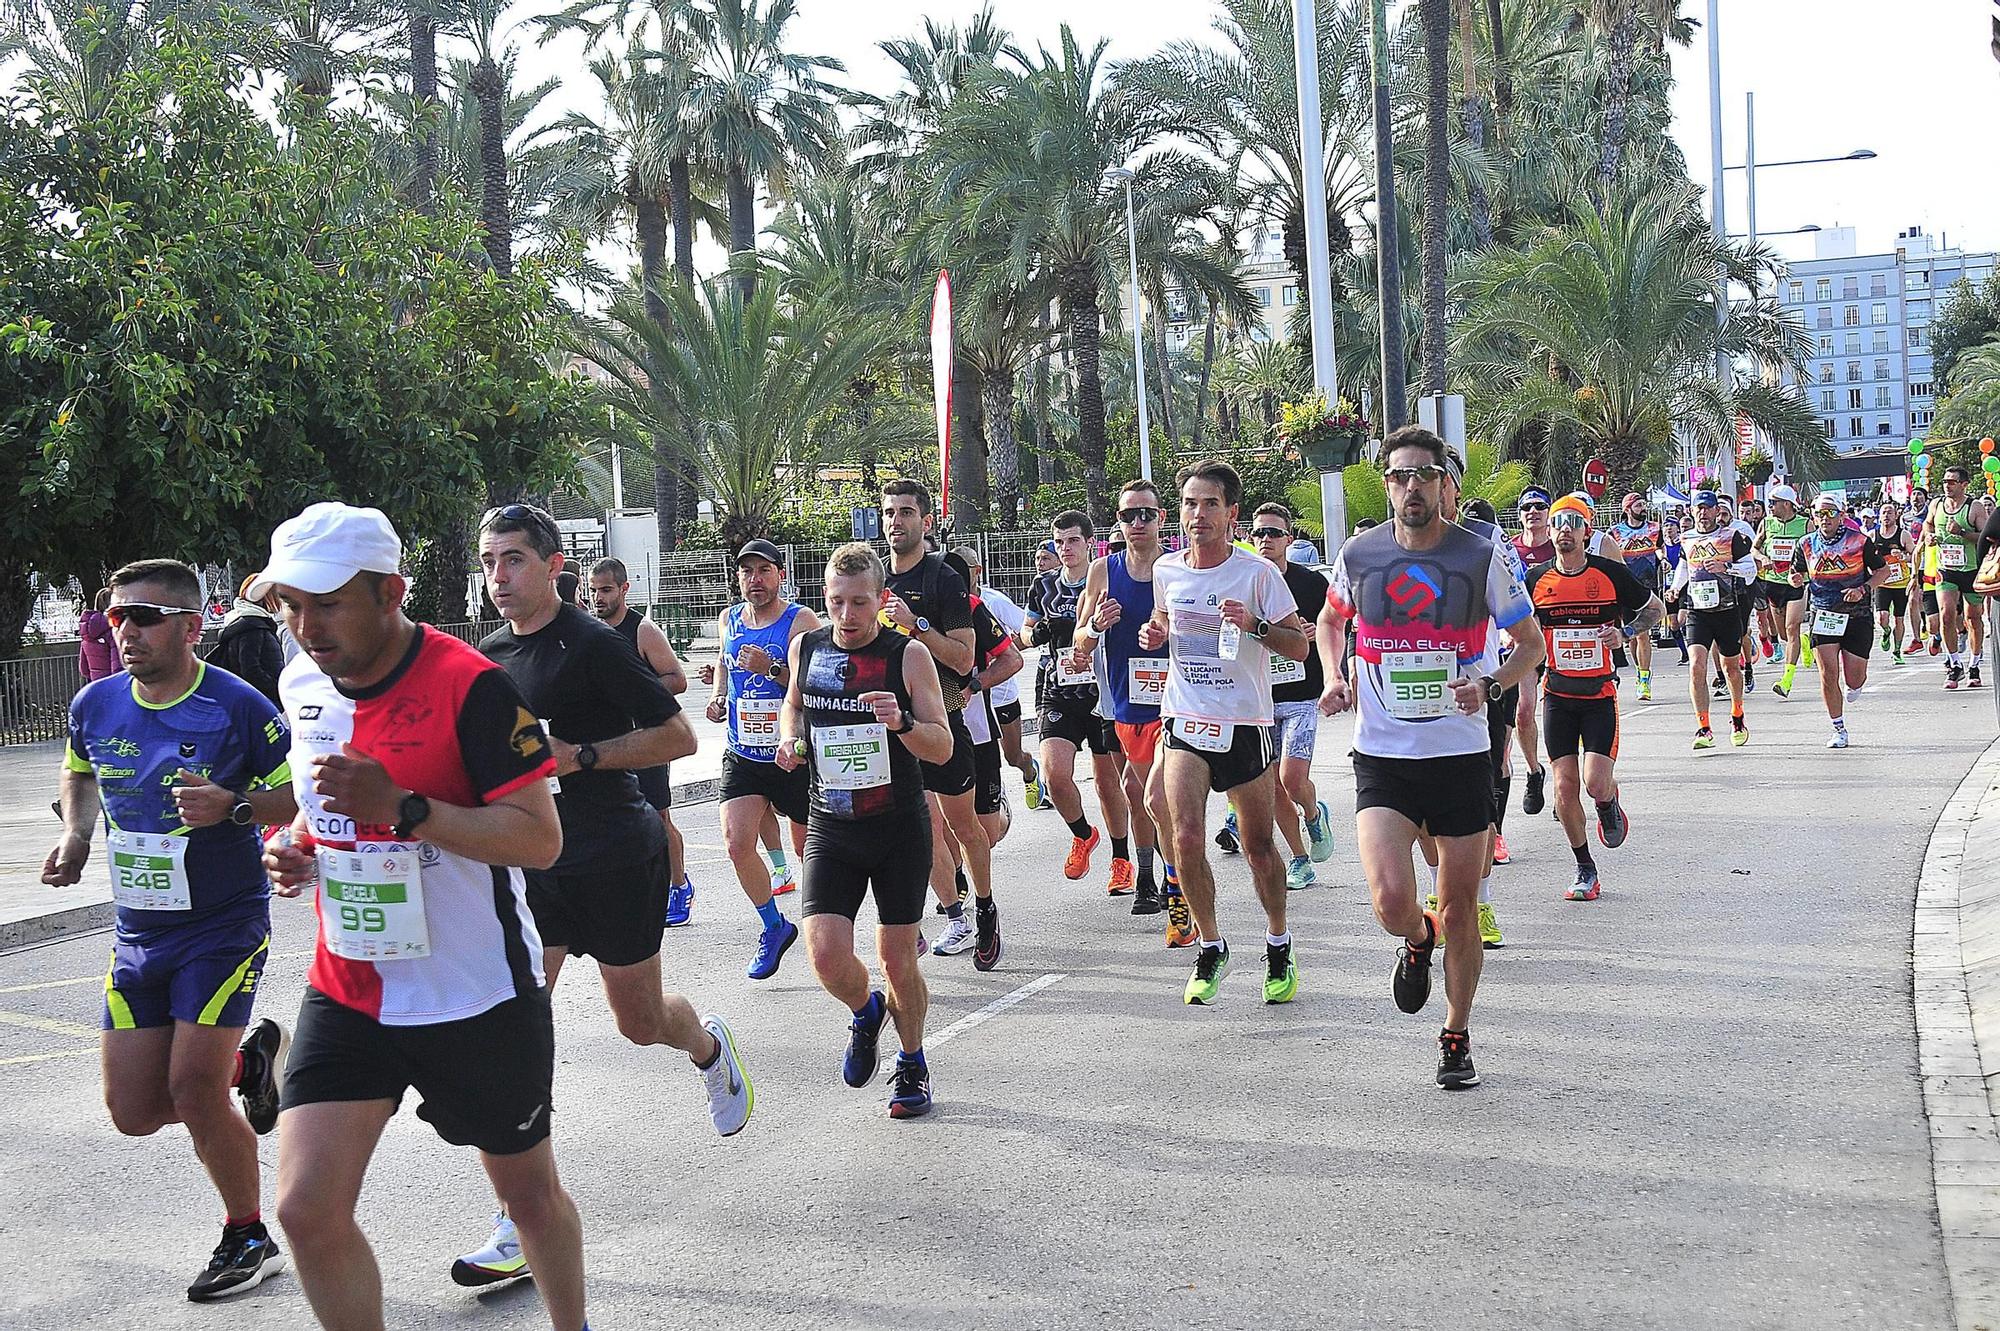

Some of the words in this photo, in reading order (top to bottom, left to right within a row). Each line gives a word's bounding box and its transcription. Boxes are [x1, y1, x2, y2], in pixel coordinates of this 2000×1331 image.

[1549, 606, 1600, 617] cableworld
[1823, 622, 1836, 630] 115
[1362, 636, 1412, 651] MEDIA
[1561, 650, 1594, 661] 489
[1214, 678, 1235, 686] POLA
[1396, 684, 1443, 701] 399
[743, 722, 774, 734] 526
[1184, 720, 1222, 738] 873
[837, 755, 869, 774] 75
[120, 869, 172, 890] 248
[340, 905, 386, 933] 99
